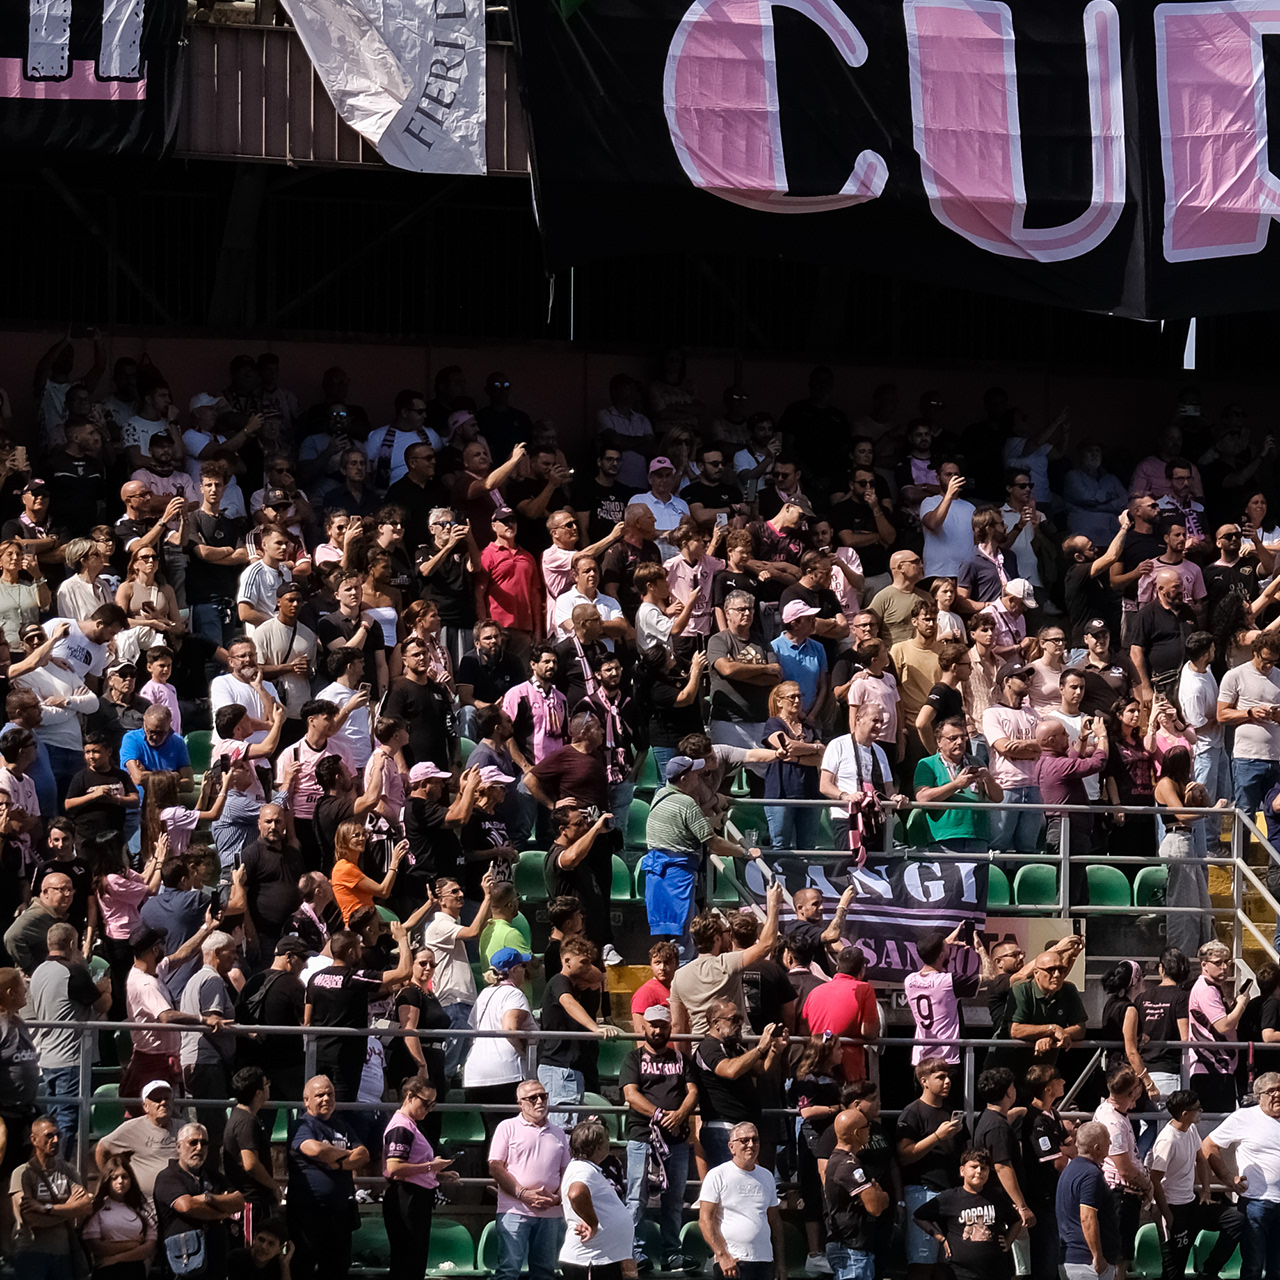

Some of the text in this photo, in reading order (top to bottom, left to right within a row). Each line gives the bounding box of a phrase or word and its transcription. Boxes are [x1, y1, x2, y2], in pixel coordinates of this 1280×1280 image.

[402, 37, 467, 153] FIERI
[744, 860, 978, 904] GANGI
[916, 994, 935, 1027] 9
[958, 1204, 996, 1225] JORDAN
